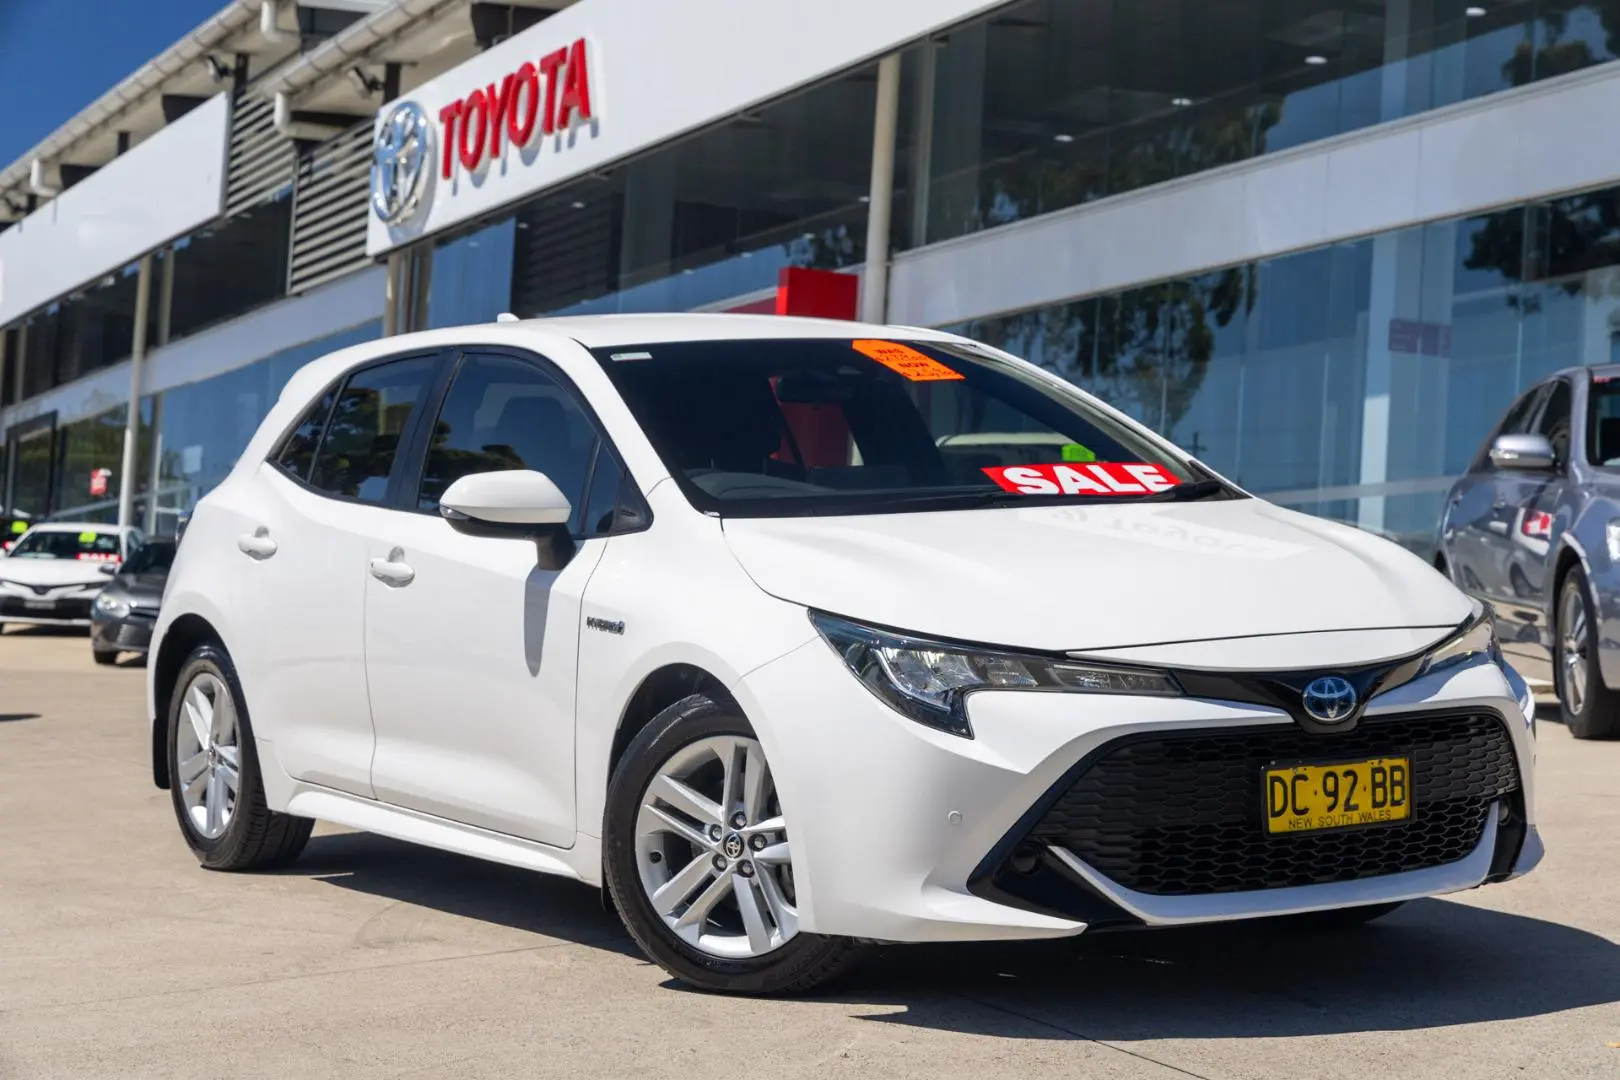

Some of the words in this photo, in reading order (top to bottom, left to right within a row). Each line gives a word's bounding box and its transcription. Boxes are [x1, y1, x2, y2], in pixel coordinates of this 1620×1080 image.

[439, 37, 592, 180] TOYOTA
[1003, 465, 1175, 494] SALE
[1288, 817, 1312, 829] NEW
[1317, 812, 1354, 827] SOUTH
[1358, 809, 1392, 823] WALES
